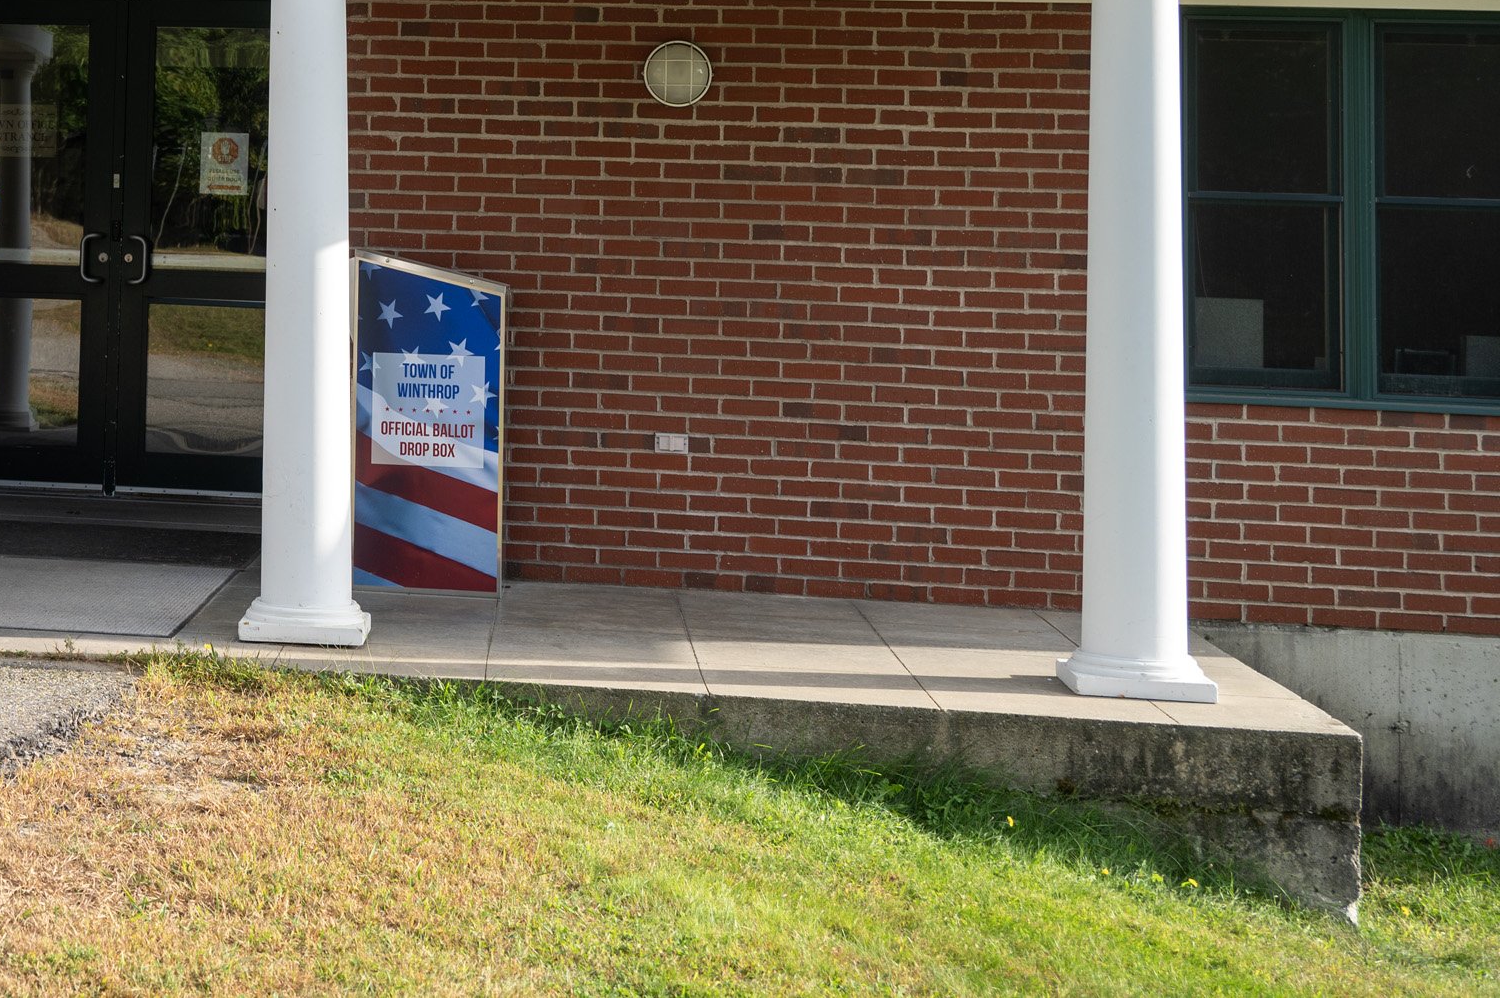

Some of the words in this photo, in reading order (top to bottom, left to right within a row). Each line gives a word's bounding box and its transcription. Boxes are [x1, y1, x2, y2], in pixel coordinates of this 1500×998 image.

[402, 363, 437, 379] TOWN
[440, 364, 455, 380] OF
[397, 383, 460, 400] WINTHROP
[381, 421, 430, 437] OFFICIAL
[432, 423, 475, 439] BALLOT
[400, 442, 429, 456] DROP
[432, 443, 455, 458] BOX
